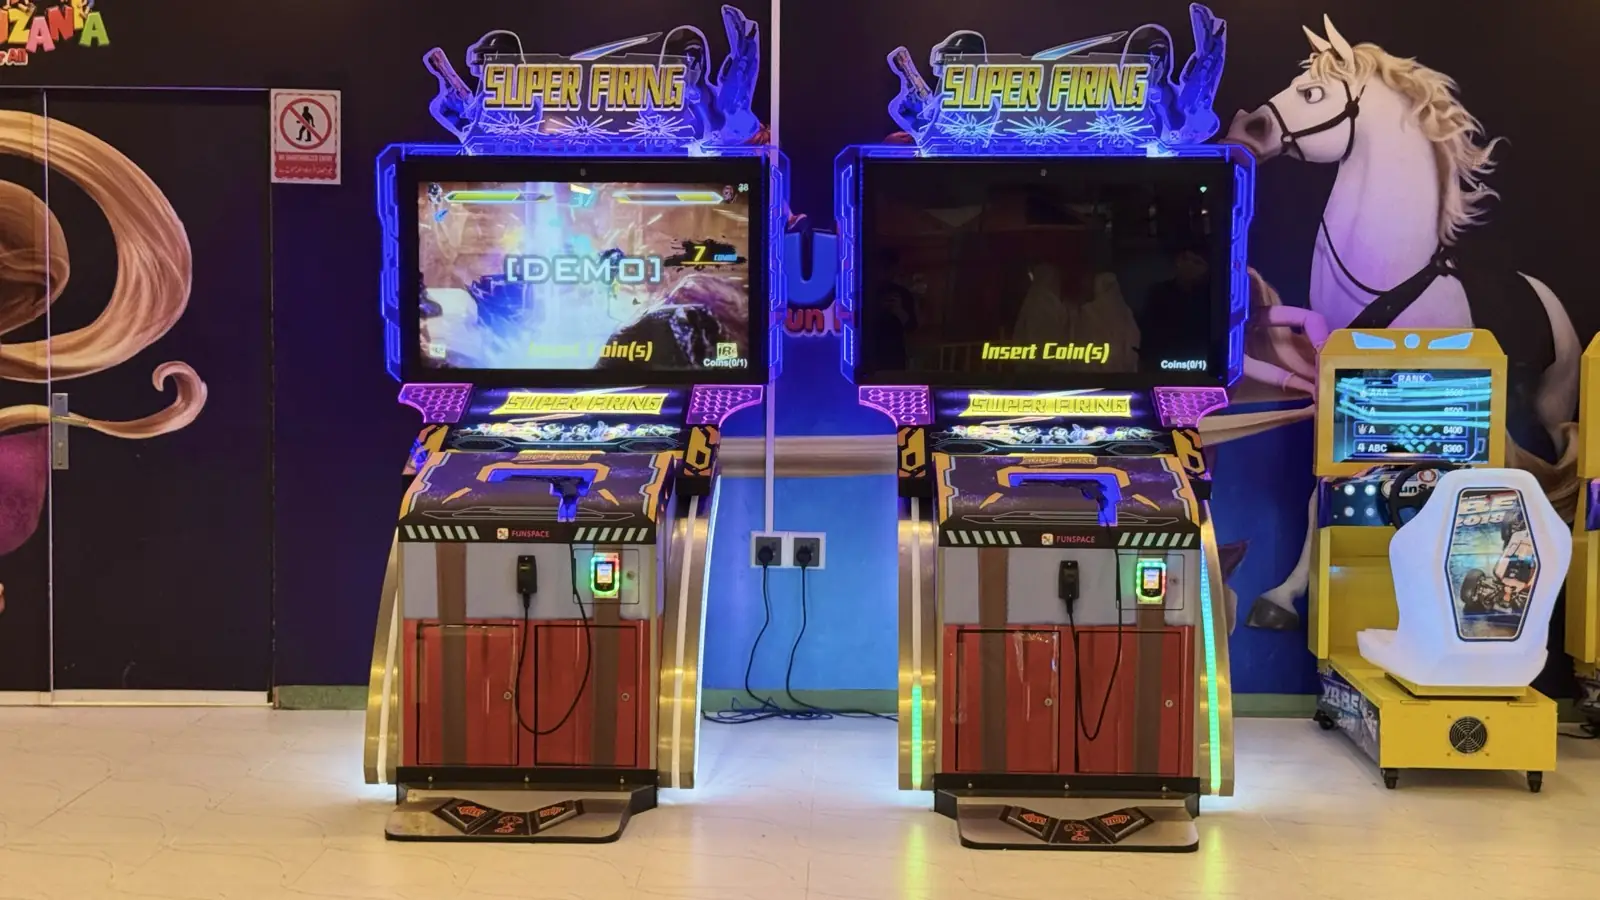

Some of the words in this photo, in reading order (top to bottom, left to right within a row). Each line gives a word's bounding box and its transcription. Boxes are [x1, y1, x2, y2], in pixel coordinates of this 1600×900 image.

[484, 64, 582, 111] SUPER
[588, 64, 687, 111] FIRING
[941, 64, 1044, 111] SUPER
[1047, 64, 1152, 111] FIRING
[694, 246, 706, 261] 7
[982, 343, 1037, 359] Insert
[1043, 343, 1109, 363] Coin(s)
[703, 358, 748, 368] Coins(0/1)
[1161, 360, 1206, 371] Coins(0/1)
[1398, 374, 1426, 384] RANK
[505, 396, 580, 410] SUPER
[587, 396, 661, 410] FIRING
[972, 398, 1045, 413] SUPER
[1054, 398, 1127, 413] FIRING
[1368, 426, 1376, 434] A
[1367, 445, 1388, 453] ABC
[511, 530, 551, 538] FUNSPACE
[1056, 535, 1096, 543] FUNSPACE
